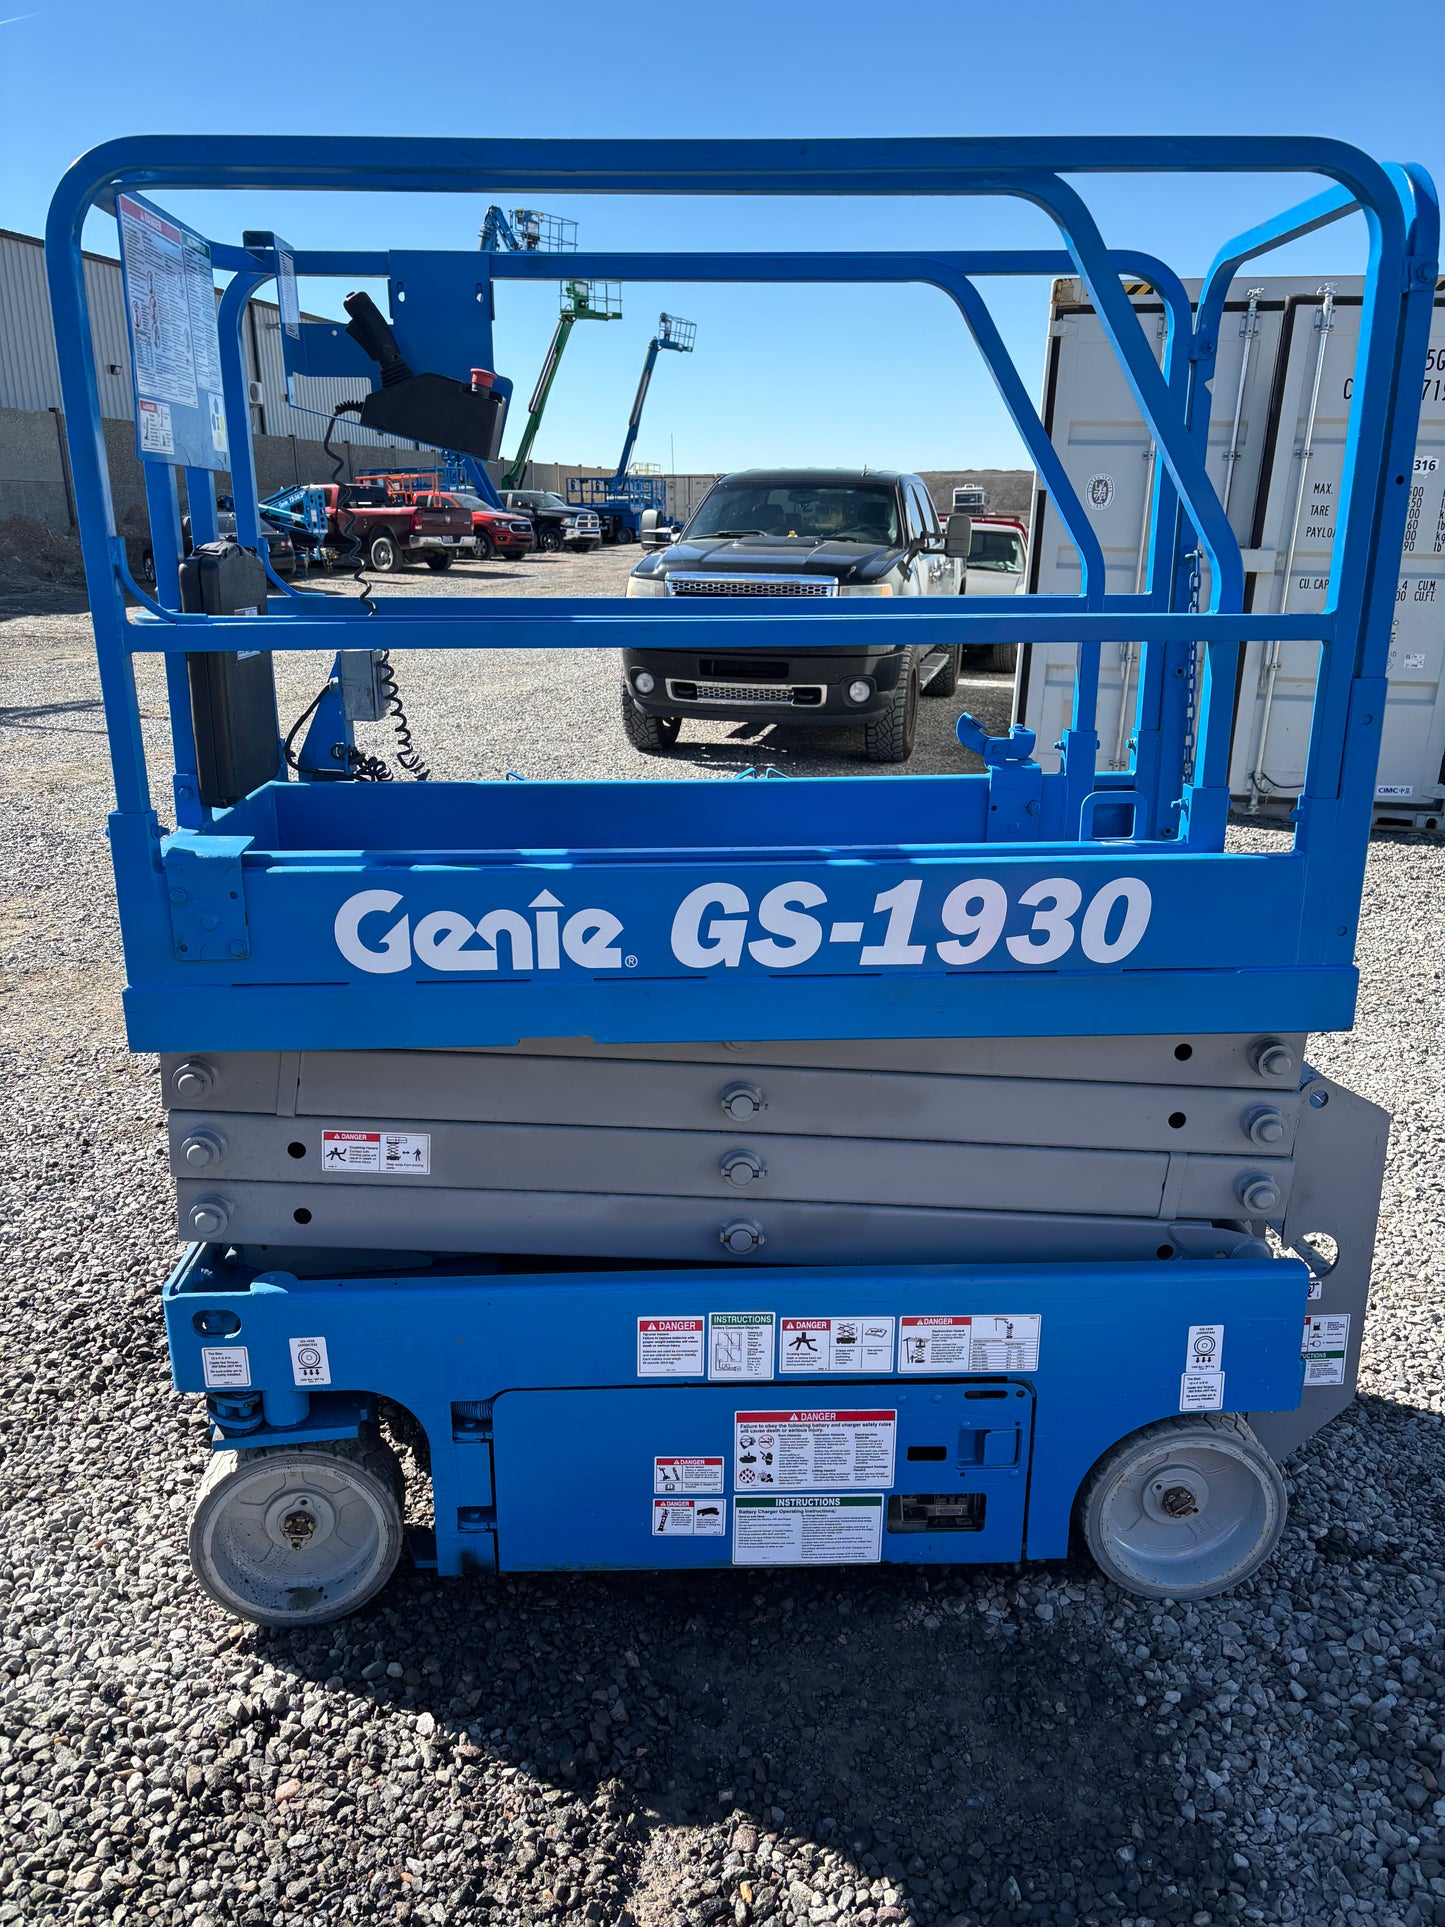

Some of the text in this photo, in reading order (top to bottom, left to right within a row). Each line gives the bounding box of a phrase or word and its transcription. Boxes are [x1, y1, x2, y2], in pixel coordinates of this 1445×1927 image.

[1421, 380, 1445, 402] 71
[1413, 460, 1436, 471] 316
[1314, 484, 1333, 495] MAX.
[1311, 506, 1330, 516] TARE
[1299, 579, 1311, 590] CU.
[670, 877, 1152, 969] GS-1930
[334, 888, 624, 974] Genie
[659, 1322, 696, 1330] DANGER
[801, 1413, 836, 1421] DANGER
[775, 1498, 840, 1506] INSTRUCTIONS
